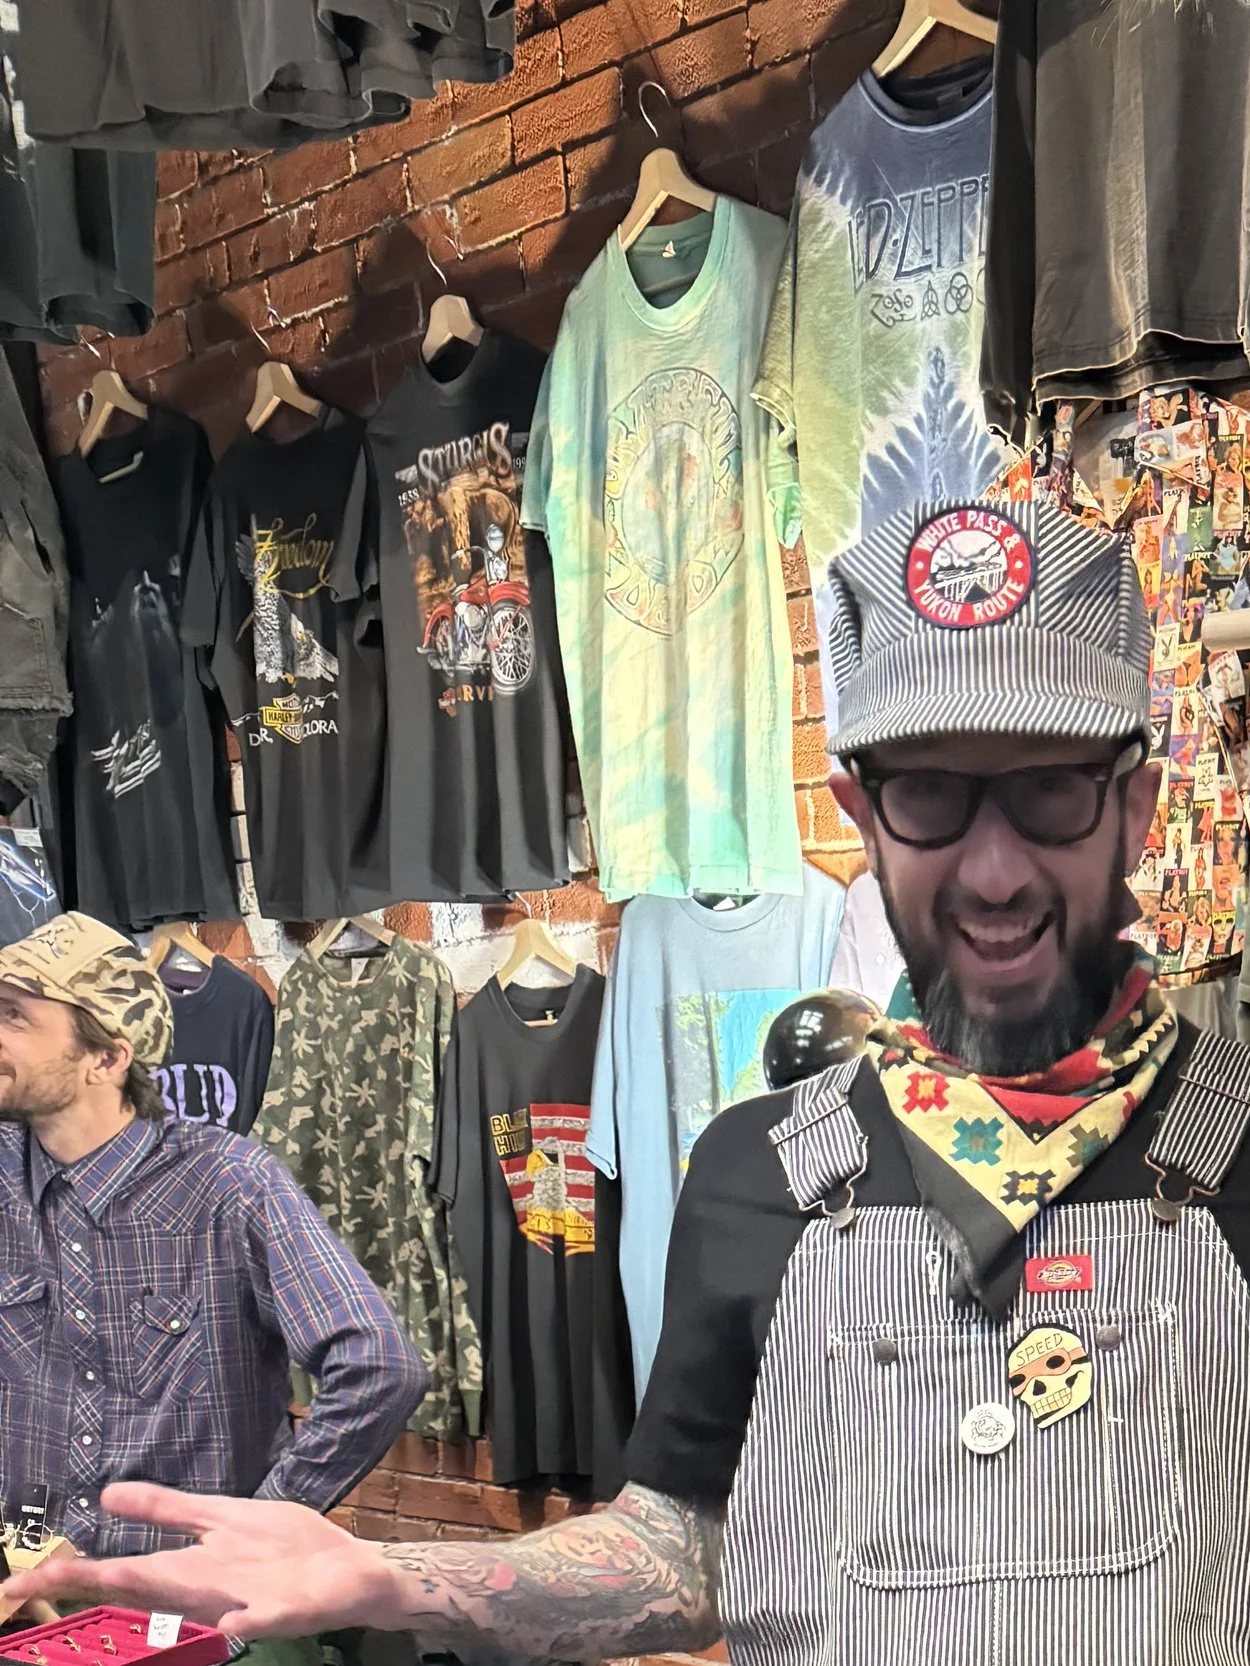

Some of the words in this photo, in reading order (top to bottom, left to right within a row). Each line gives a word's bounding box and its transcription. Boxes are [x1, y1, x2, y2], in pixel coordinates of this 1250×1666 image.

[417, 421, 513, 489] STURGIS
[915, 512, 960, 552] WHITE
[966, 510, 1007, 536] PASS
[1004, 533, 1021, 553] &
[914, 578, 963, 622] YUKON
[973, 577, 1025, 622] ROUTE
[1016, 1332, 1063, 1367] SPEED
